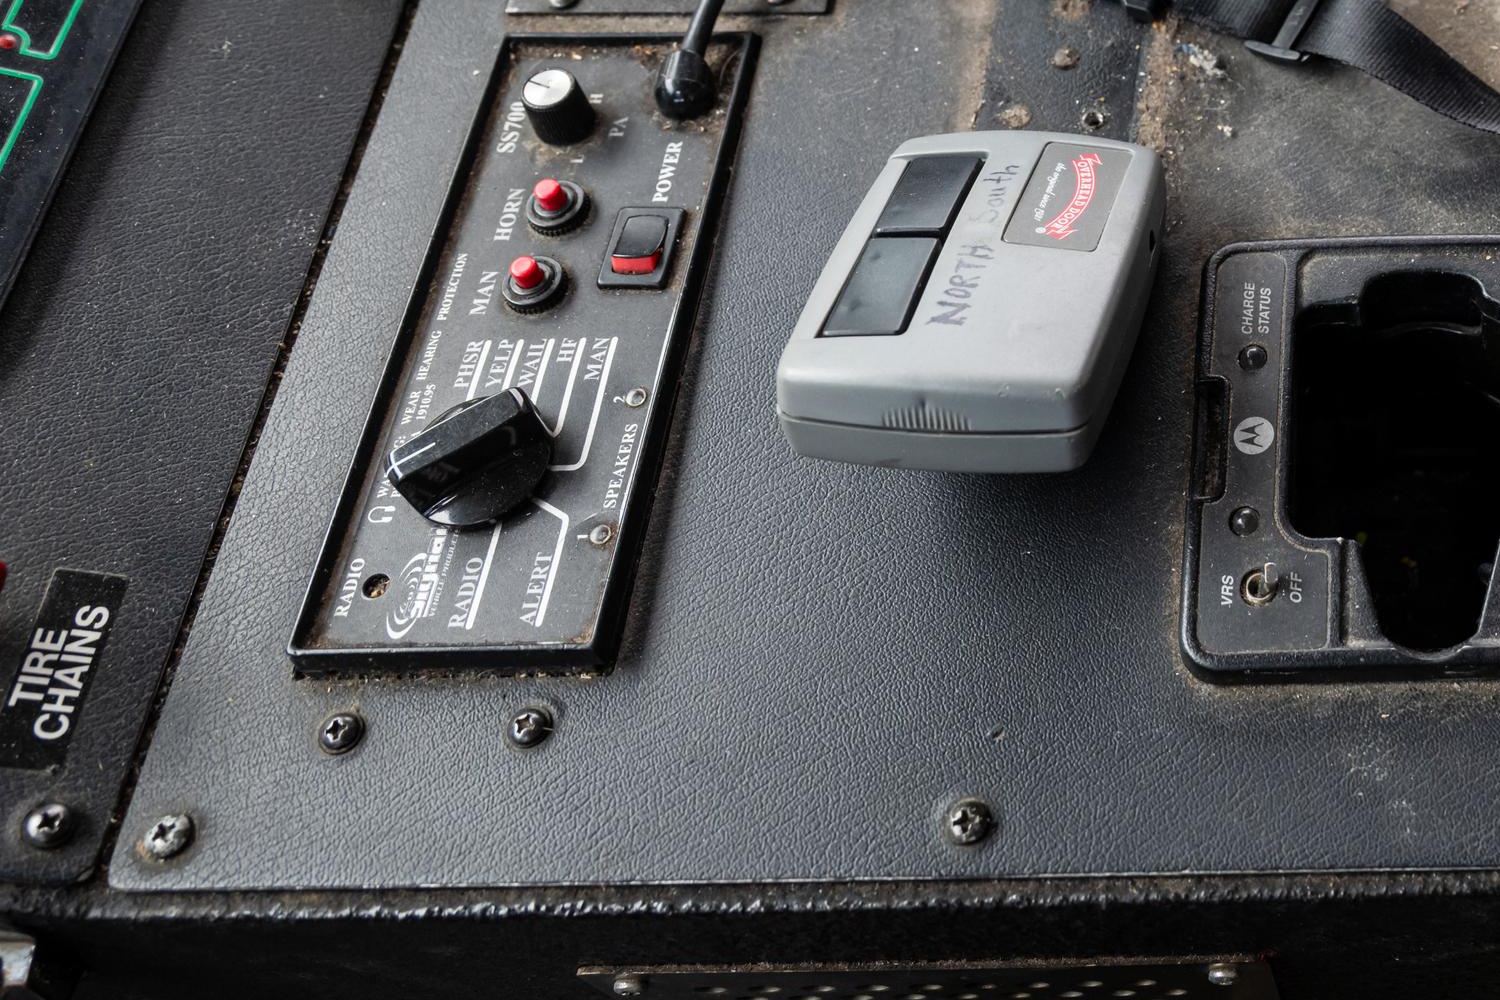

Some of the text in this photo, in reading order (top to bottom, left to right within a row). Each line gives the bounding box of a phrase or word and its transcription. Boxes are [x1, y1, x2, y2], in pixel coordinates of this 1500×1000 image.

[496, 102, 526, 154] SS700
[608, 117, 629, 137] PA
[652, 141, 683, 202] POWER
[1050, 161, 1092, 229] OVERHEAD DOOR
[493, 188, 526, 242] HORN
[469, 270, 498, 315] MAN
[925, 244, 994, 326] NORTH
[1241, 282, 1256, 335] CHARGE
[1258, 287, 1272, 335] STATUS
[401, 390, 422, 425] WEAR
[415, 329, 442, 380] HEARING
[436, 253, 469, 321] PROTECTION
[453, 339, 485, 388] PHSR
[485, 338, 515, 388] YELP
[517, 338, 548, 387] WAIL
[556, 337, 577, 363] HF
[584, 337, 610, 380] MAN
[415, 383, 436, 420] 1910.95
[613, 394, 626, 404] 2
[603, 422, 639, 509] SPEAKERS
[577, 533, 588, 541] 1
[334, 557, 366, 618] RADIO
[447, 556, 484, 629] RADIO
[519, 551, 553, 625] ALERT
[1220, 574, 1234, 606] VRS
[1289, 571, 1302, 604] OFF
[8, 628, 68, 706] TIRE
[33, 605, 110, 741] CHAINS
